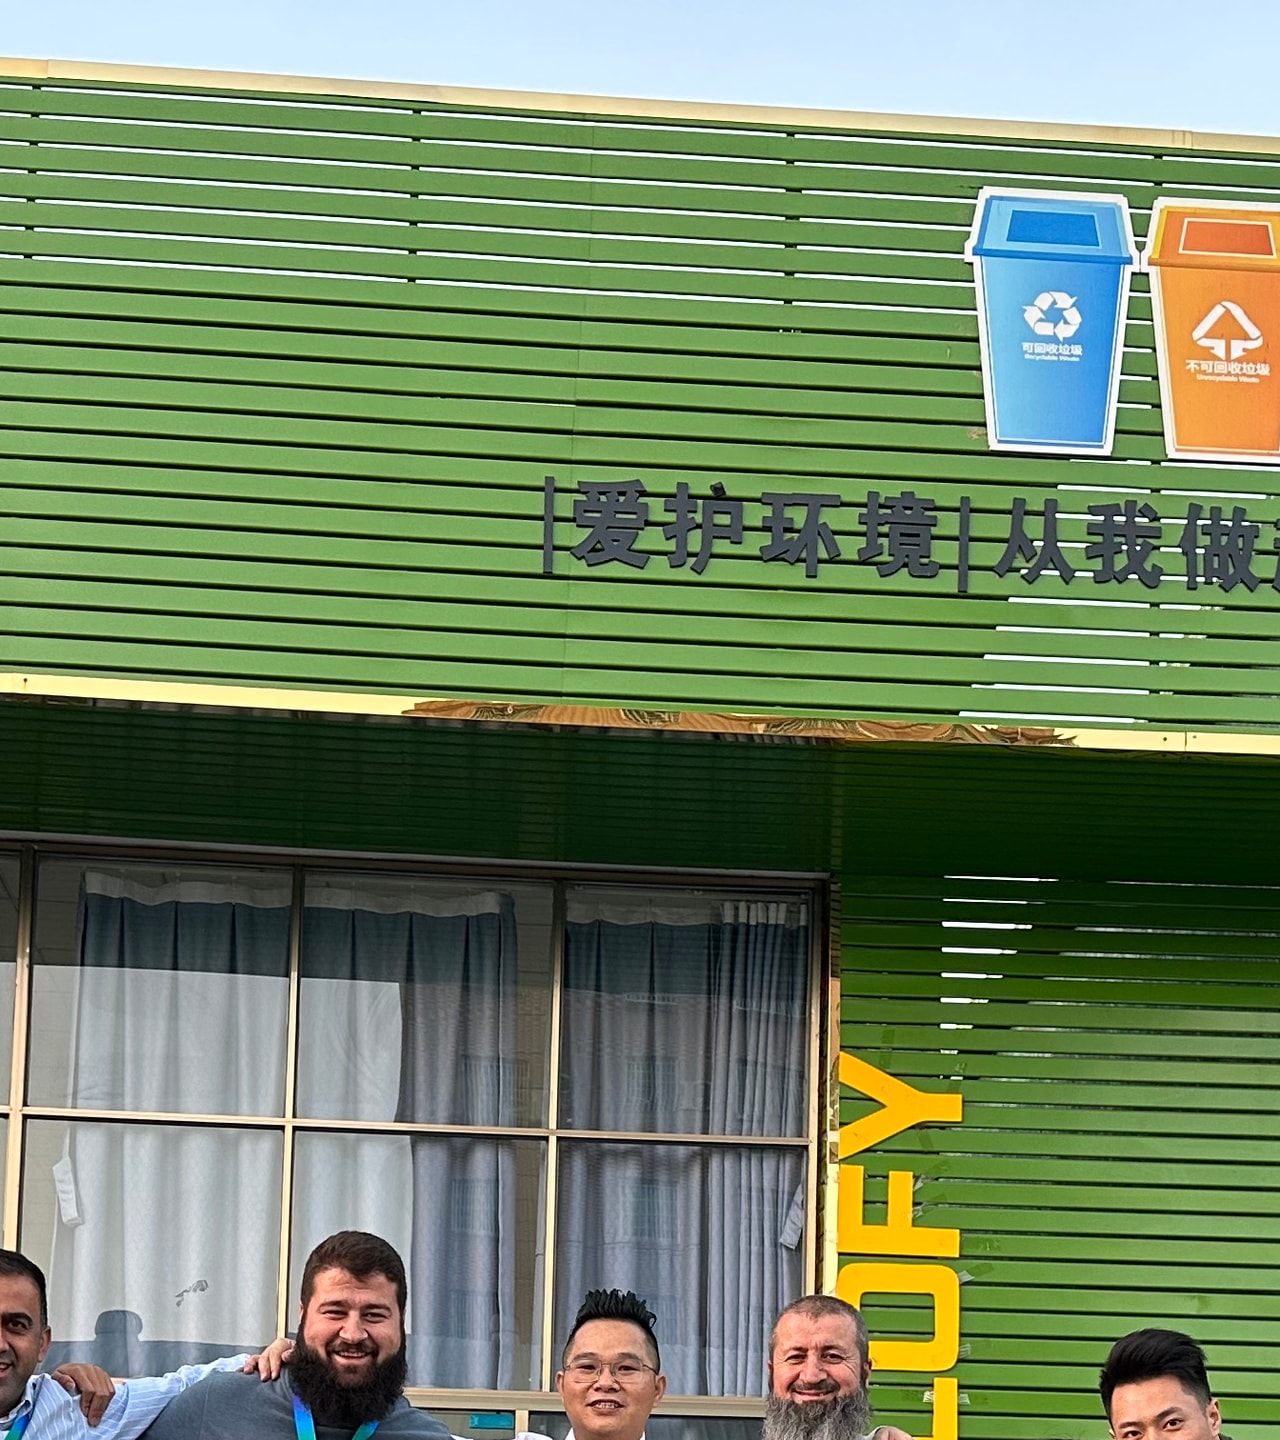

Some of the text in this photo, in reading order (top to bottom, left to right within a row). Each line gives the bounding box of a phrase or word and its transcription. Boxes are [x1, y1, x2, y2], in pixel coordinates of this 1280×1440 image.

[1021, 342, 1083, 356] 可回收垃圾
[1185, 359, 1270, 376] 不可回收垃圾
